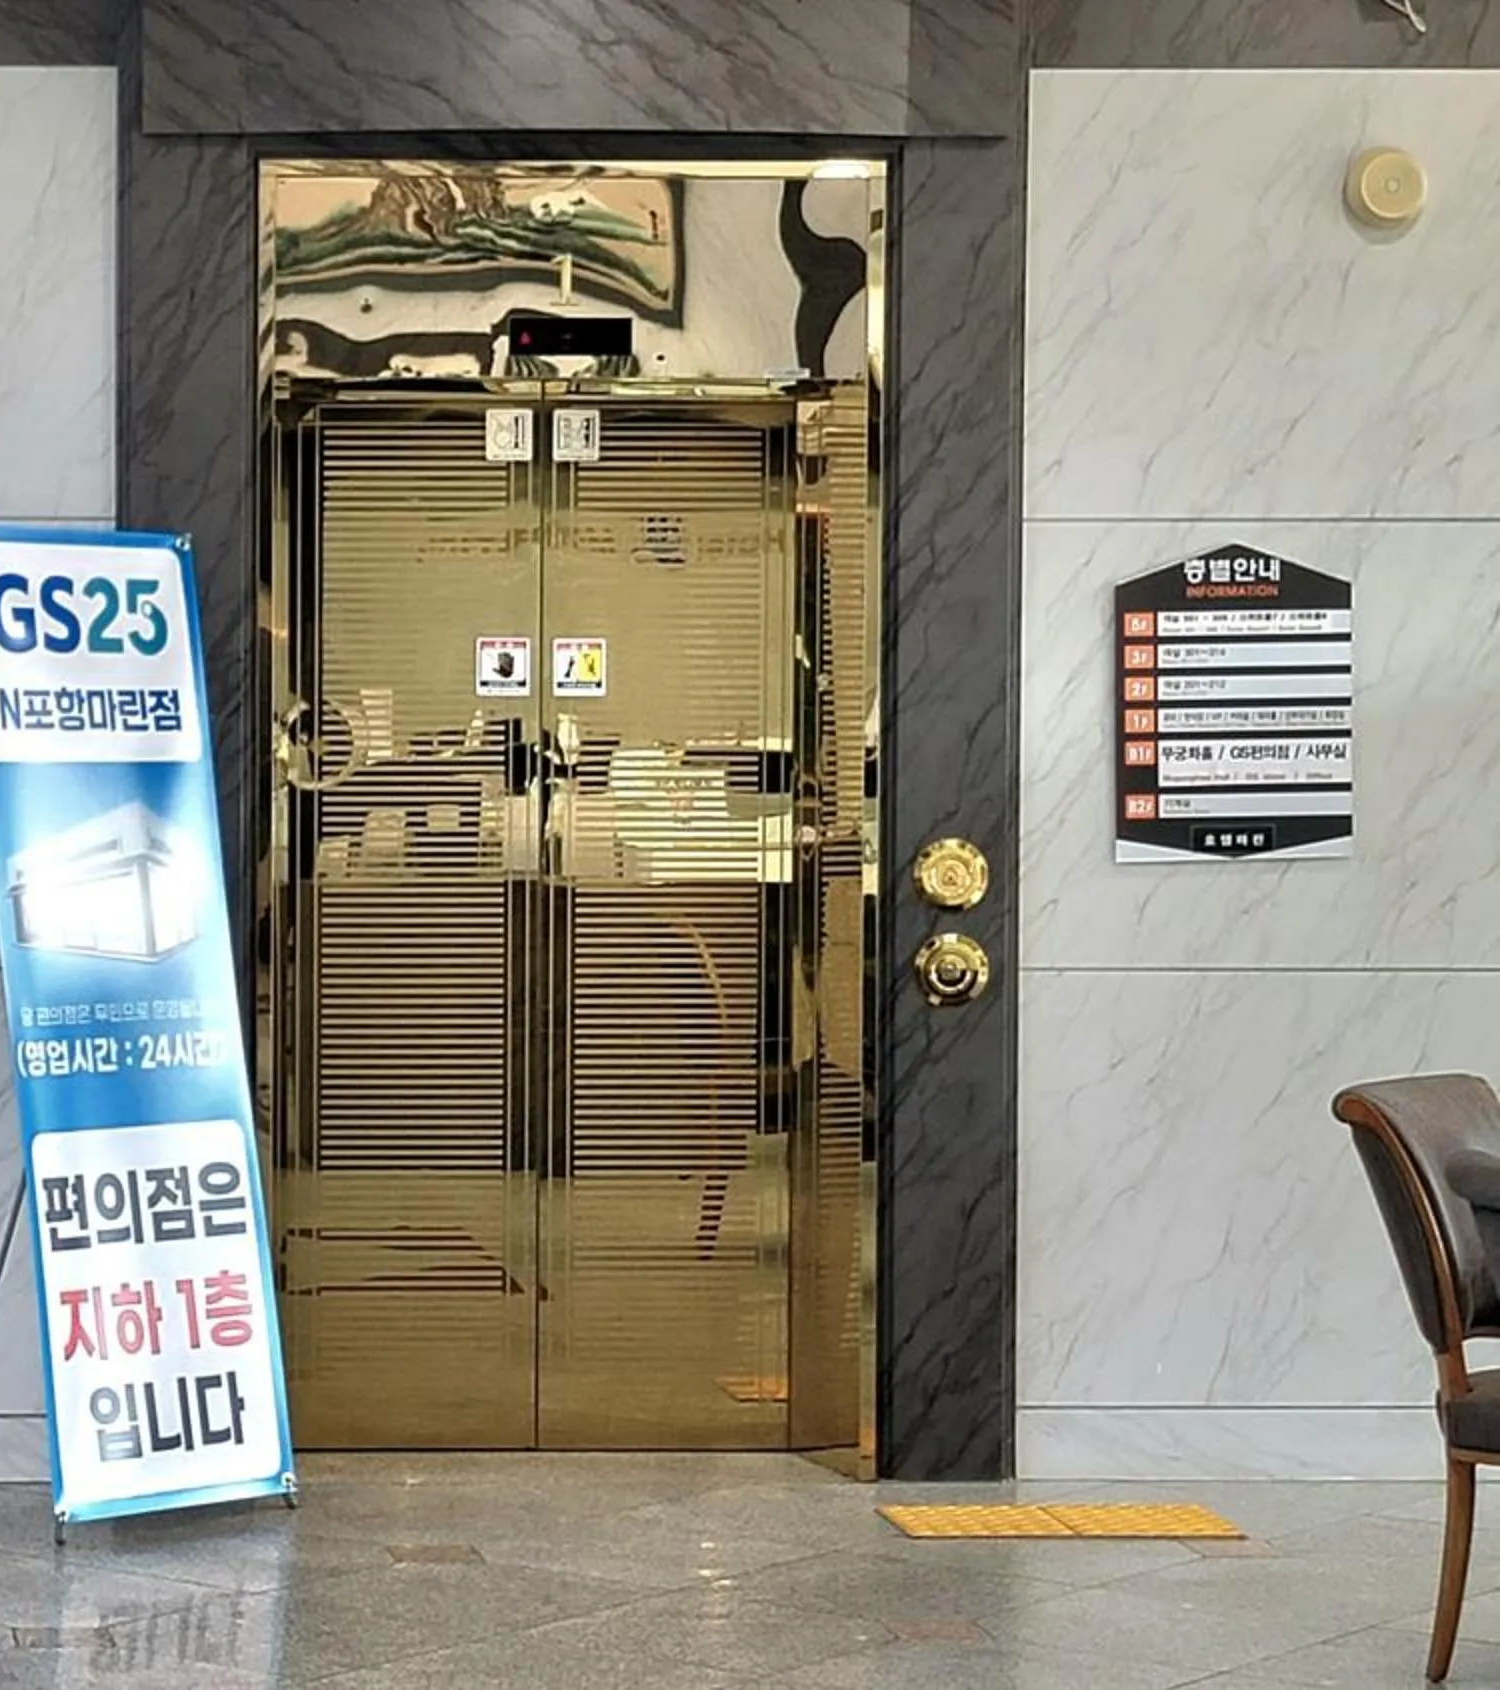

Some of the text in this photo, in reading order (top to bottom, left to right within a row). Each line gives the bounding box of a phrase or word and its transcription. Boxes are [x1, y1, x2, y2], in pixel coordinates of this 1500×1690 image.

[1186, 584, 1279, 598] INFORMATION
[1229, 744, 1291, 761] GS편의점
[1306, 742, 1348, 760] 사무실
[17, 1037, 119, 1078] (영업시간
[42, 1161, 248, 1252] 편의점은
[60, 1270, 253, 1361] 지하 1층
[89, 1371, 246, 1462] 입니다
